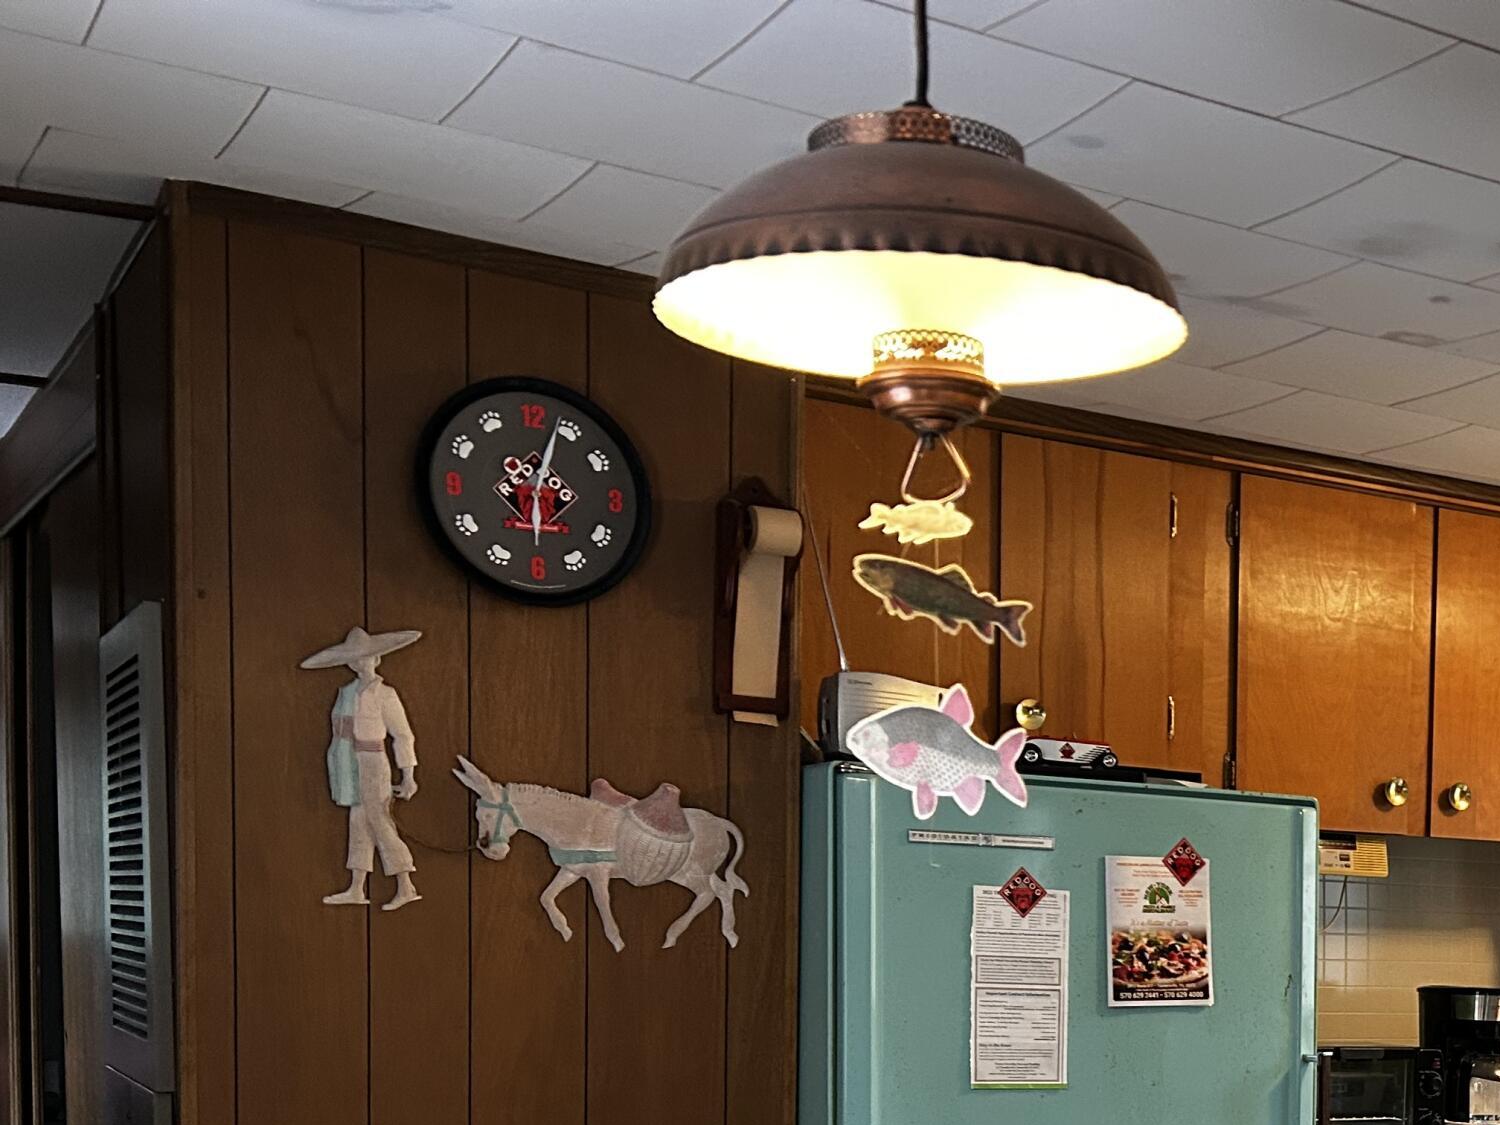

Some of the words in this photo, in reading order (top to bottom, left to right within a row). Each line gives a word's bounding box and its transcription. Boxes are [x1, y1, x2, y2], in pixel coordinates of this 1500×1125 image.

[520, 404, 545, 429] 12
[446, 471, 462, 495] 9
[498, 463, 534, 497] RED
[607, 488, 623, 512] 3
[531, 556, 546, 580] 6
[1004, 876, 1022, 897] RED
[1023, 876, 1042, 896] DOG
